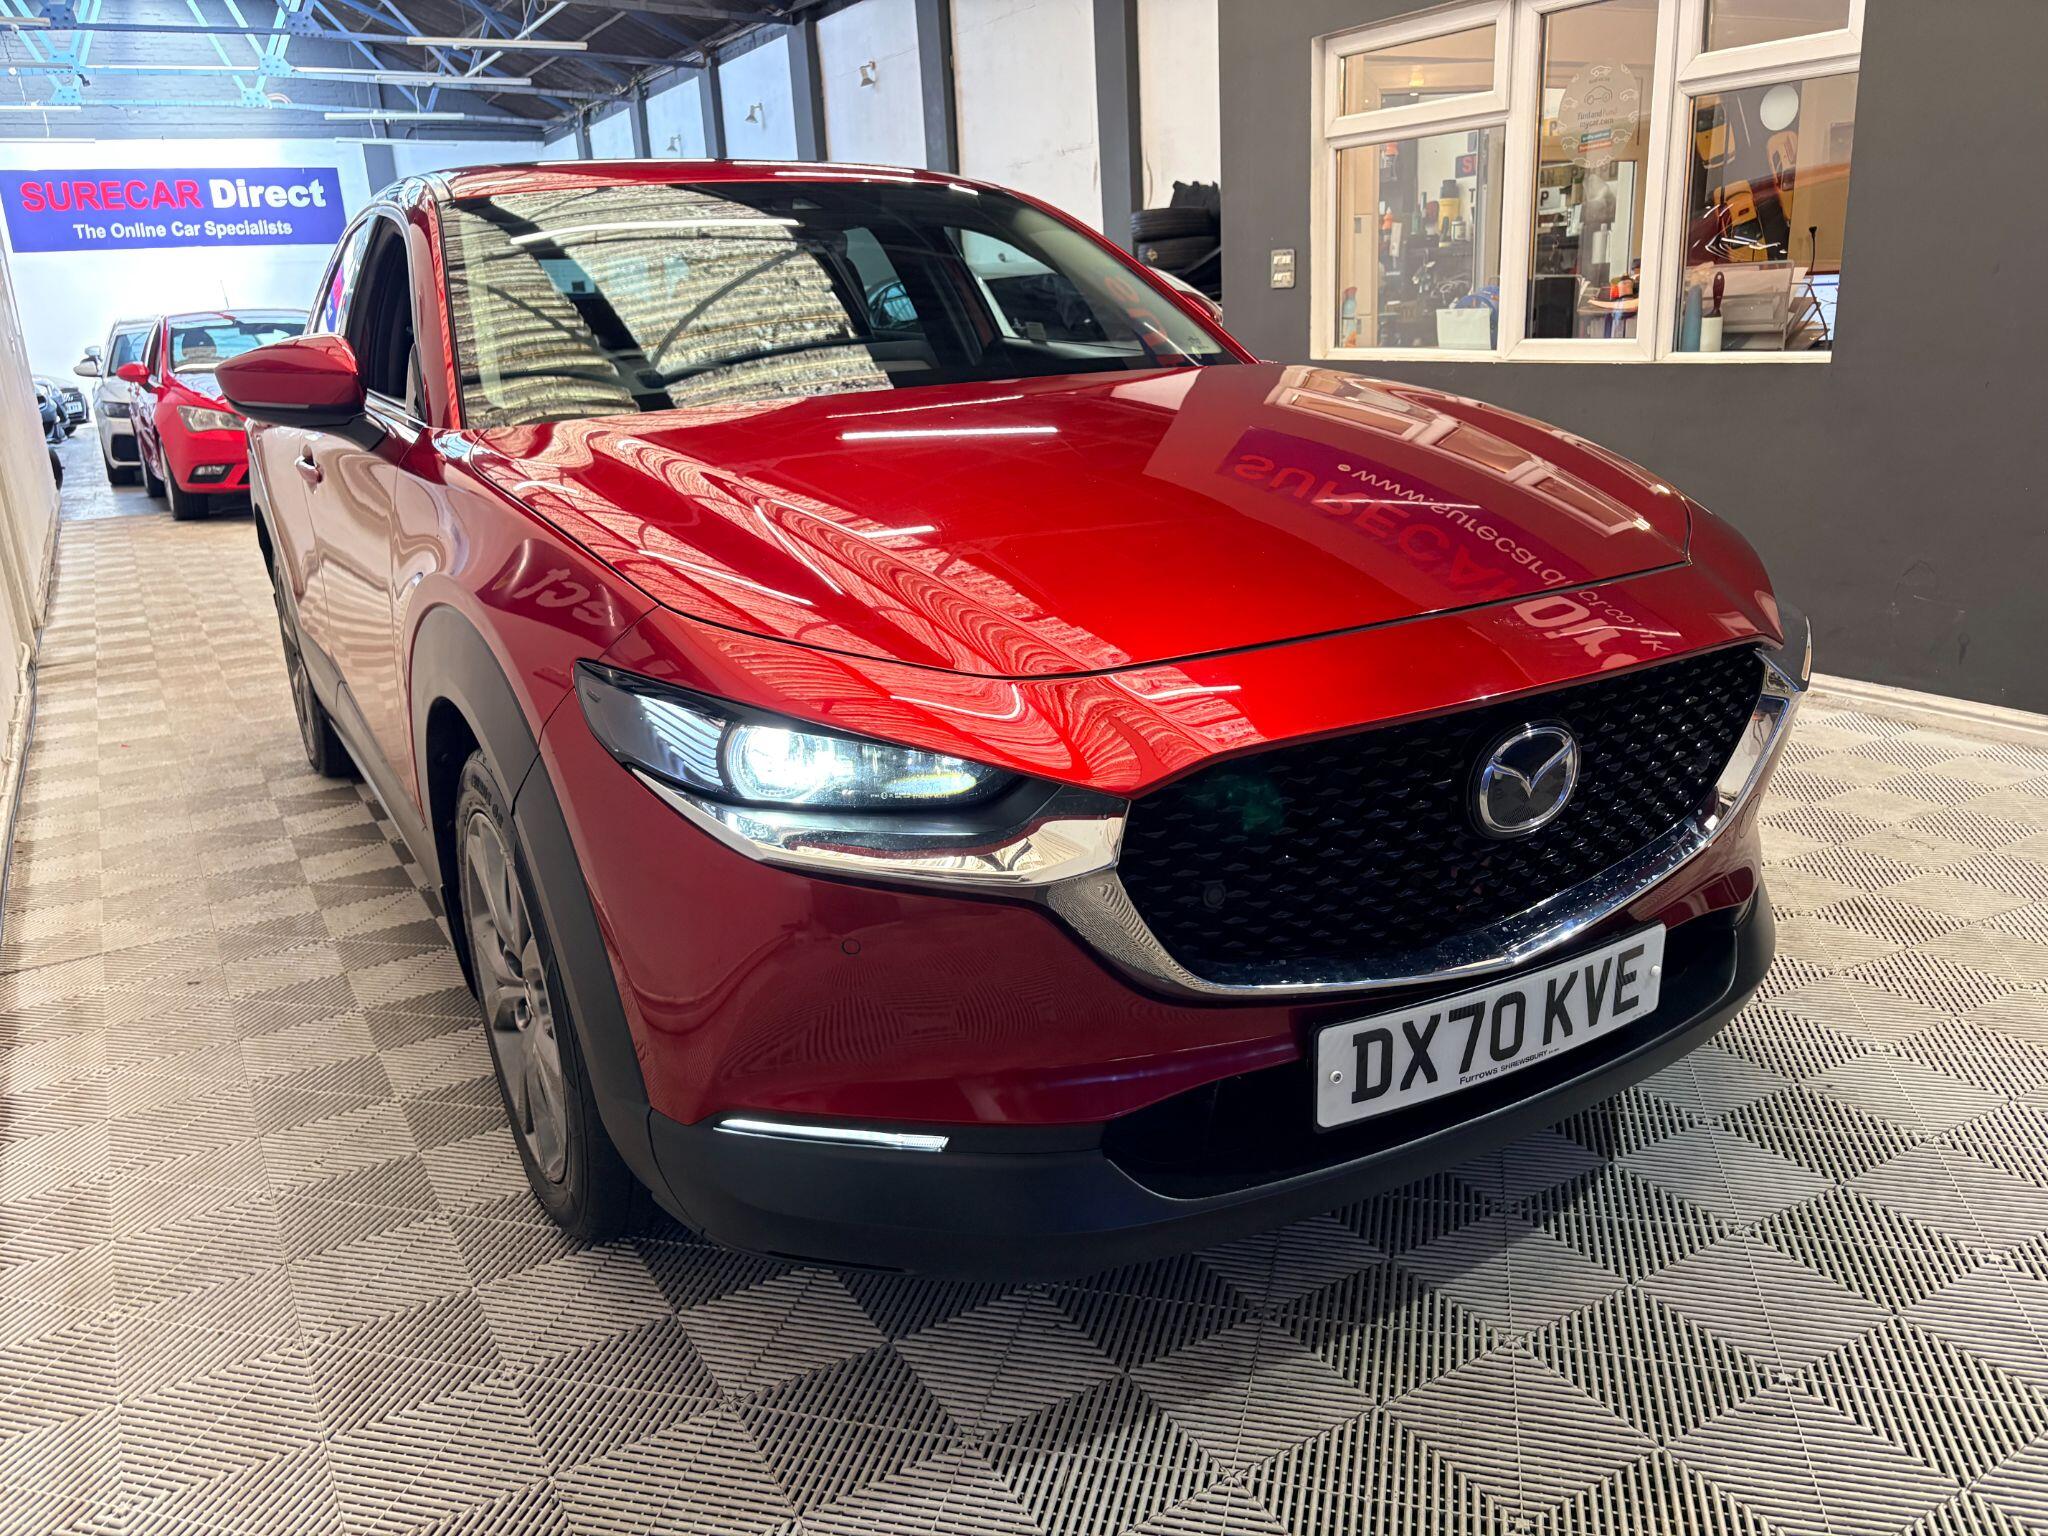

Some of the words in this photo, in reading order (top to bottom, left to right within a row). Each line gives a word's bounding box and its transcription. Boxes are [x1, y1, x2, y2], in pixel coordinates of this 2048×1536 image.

[20, 179, 204, 212] SURECAR
[208, 178, 327, 209] Direct
[73, 223, 107, 240] The
[110, 222, 167, 239] Online
[171, 221, 201, 238] Car
[204, 219, 293, 239] Specialists
[1351, 991, 1527, 1105] DX70
[1542, 943, 1645, 1047] KVE
[1458, 1067, 1498, 1085] Furrows
[1500, 1050, 1548, 1072] SHREWSBURY
